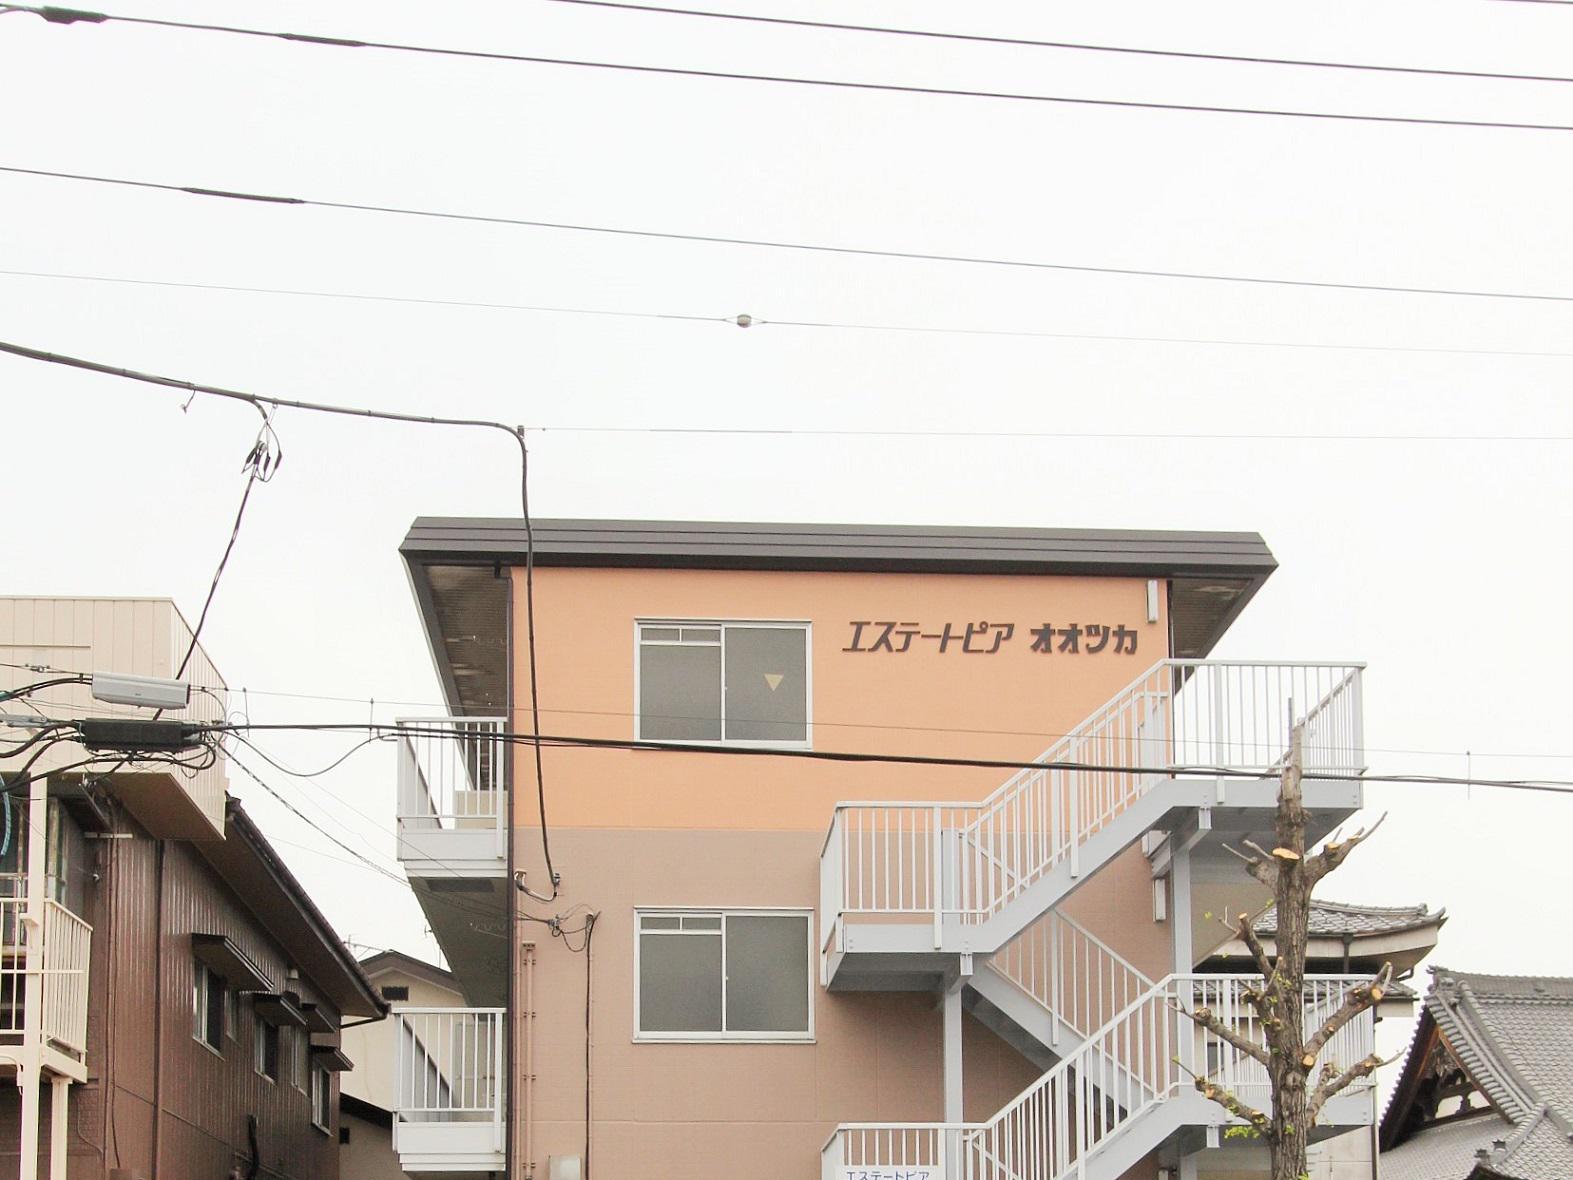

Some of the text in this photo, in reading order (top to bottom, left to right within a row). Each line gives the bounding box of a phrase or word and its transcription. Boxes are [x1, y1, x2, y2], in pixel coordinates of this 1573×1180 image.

[842, 621, 1138, 655] エステートピア オオツカ
